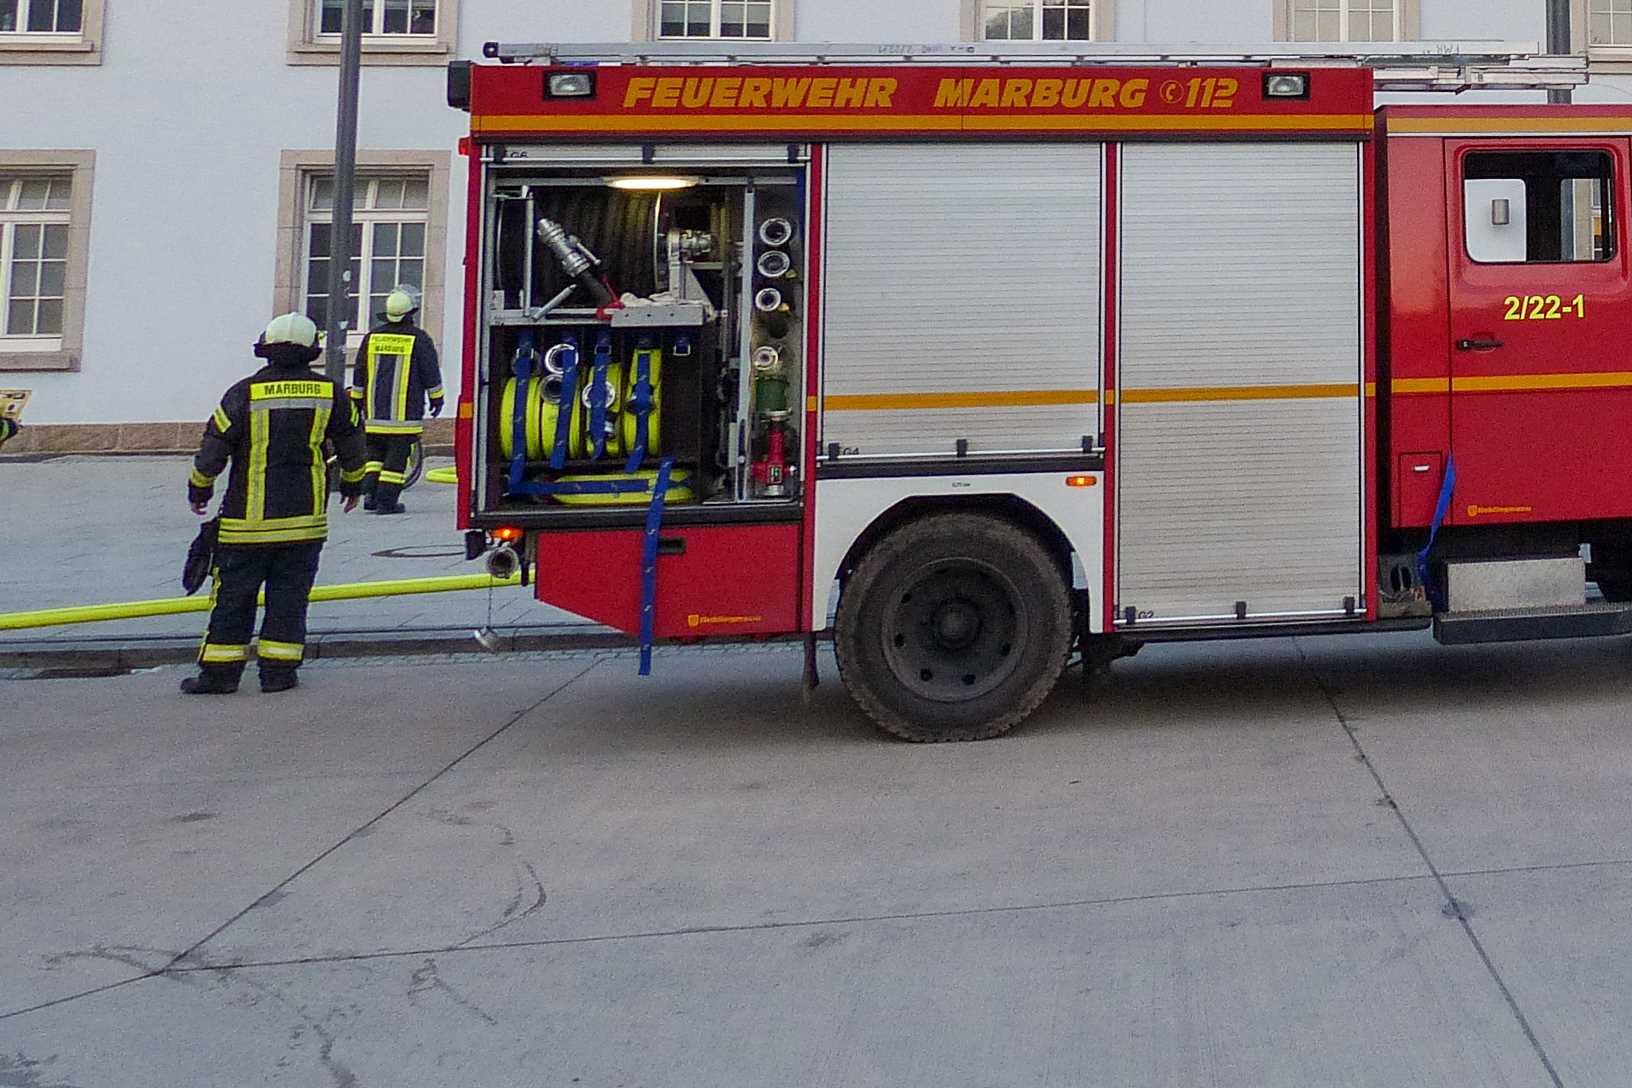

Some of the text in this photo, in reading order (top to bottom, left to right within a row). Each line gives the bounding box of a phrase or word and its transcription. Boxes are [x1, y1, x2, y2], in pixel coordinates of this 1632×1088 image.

[623, 77, 1238, 109] FEUERWEHR MARBURG 112
[1504, 294, 1585, 320] 2/22-1
[264, 383, 321, 395] MARBURG
